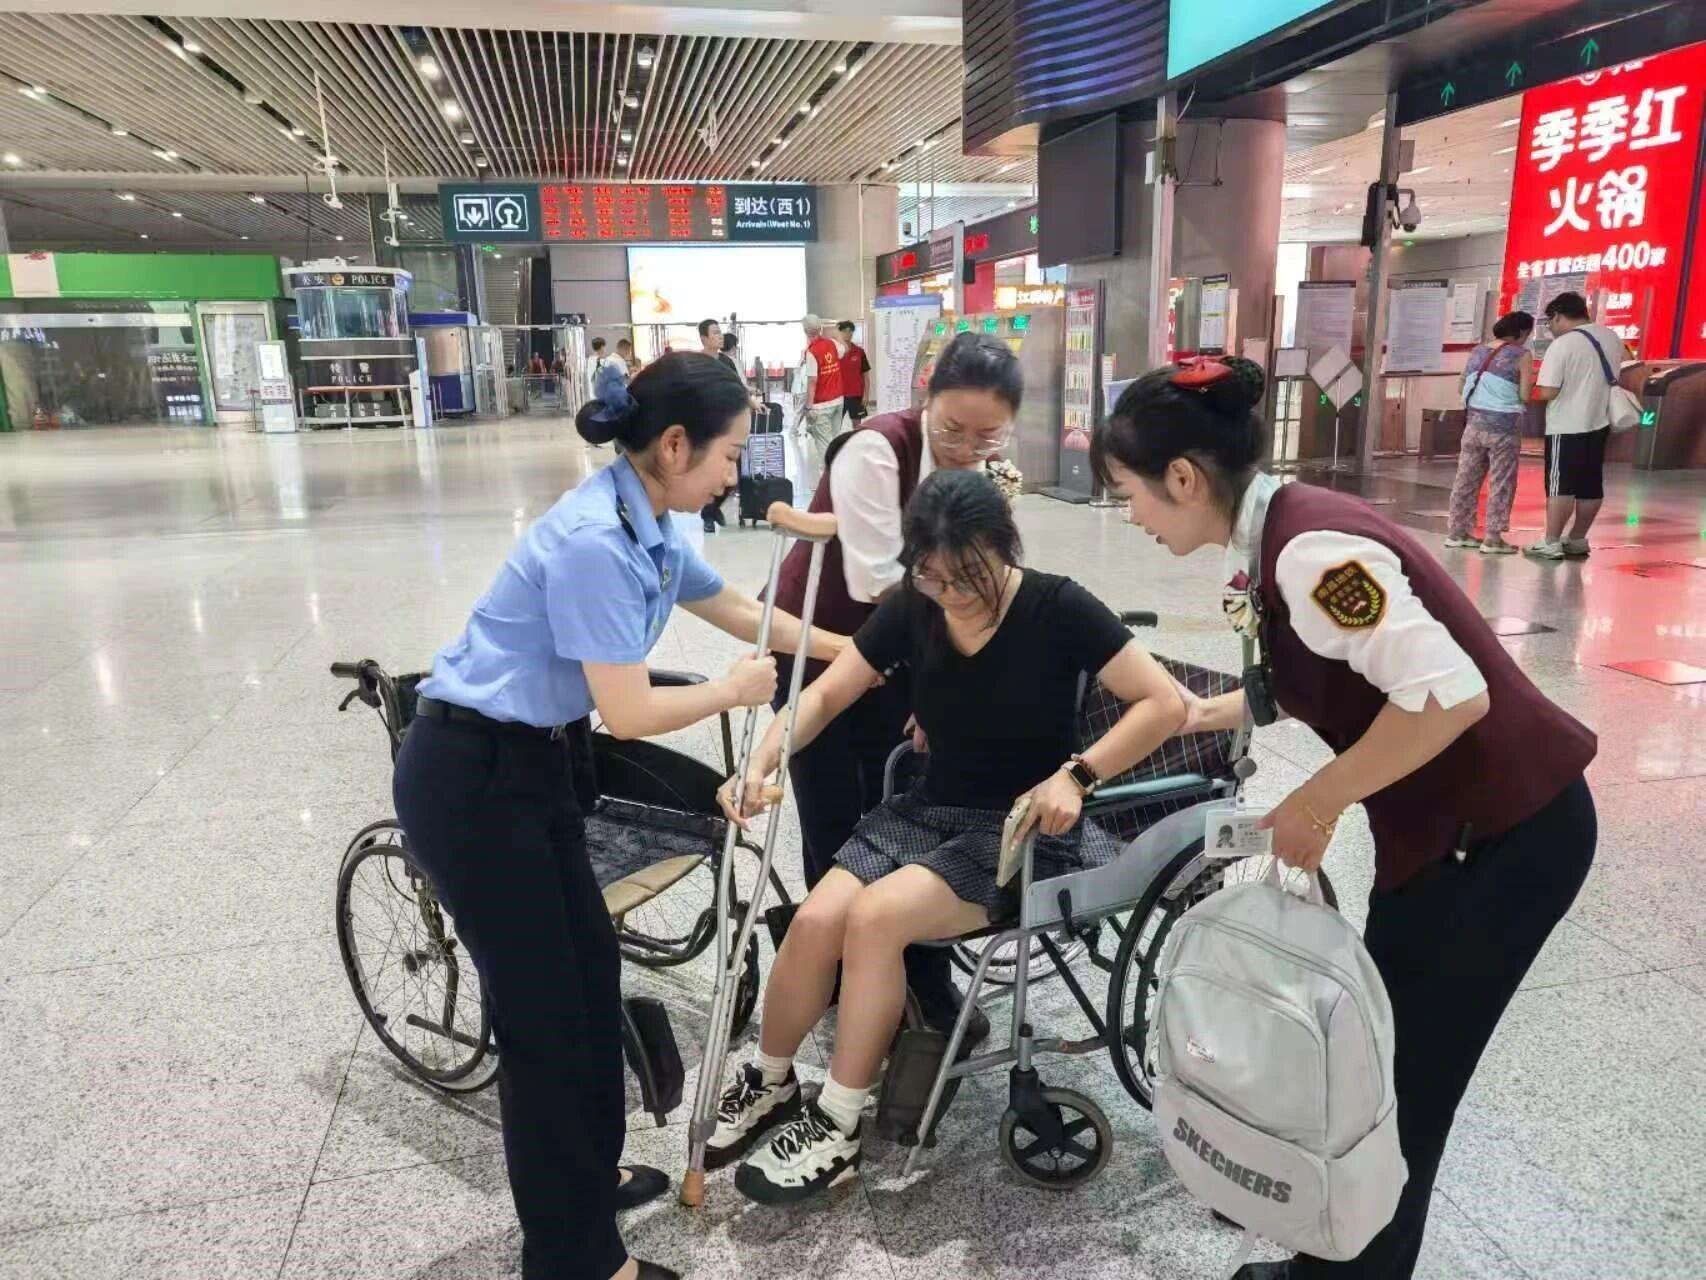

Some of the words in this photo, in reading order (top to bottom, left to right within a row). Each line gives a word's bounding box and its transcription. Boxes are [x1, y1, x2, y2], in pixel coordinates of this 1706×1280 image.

[1530, 85, 1688, 173] 季季红
[1543, 164, 1648, 237] 火锅
[302, 275, 325, 285] 公安
[351, 275, 388, 285] POLICE
[331, 375, 373, 384] POLICE
[1172, 1116, 1292, 1204] SKECHERS
